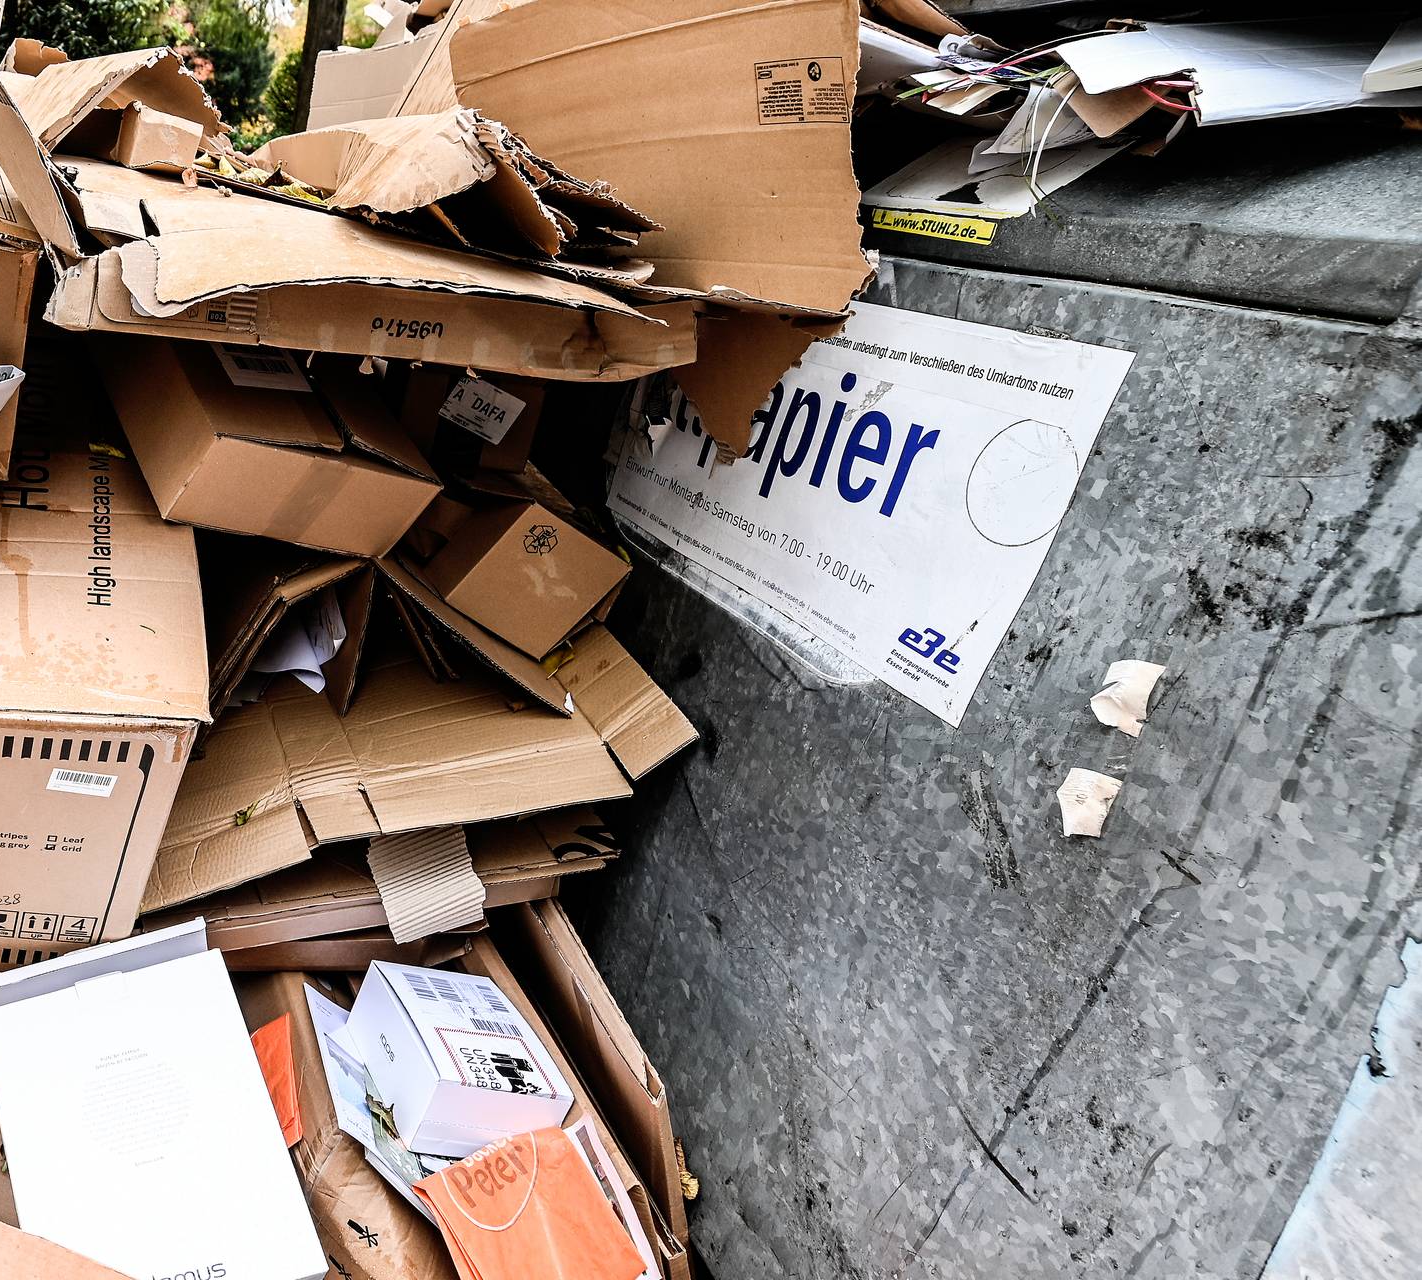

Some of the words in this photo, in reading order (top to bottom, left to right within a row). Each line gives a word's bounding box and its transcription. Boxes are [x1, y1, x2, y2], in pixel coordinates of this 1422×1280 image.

[891, 217, 977, 238] www.STUHL2.de
[852, 340, 888, 359] unbedingt
[889, 348, 906, 361] zum
[909, 352, 965, 375] Verschließen
[967, 364, 984, 379] des
[986, 366, 1038, 392] Umkartons
[1039, 381, 1074, 400] nutzen
[471, 397, 507, 424] DAFA
[88, 474, 114, 561] landscape
[626, 456, 656, 482] Einwurf
[654, 472, 669, 487] nur
[669, 477, 698, 508] Montag
[711, 501, 755, 538] Samstag
[757, 524, 776, 545] von
[779, 533, 805, 558] 7.00
[815, 552, 848, 581] 19.00
[850, 569, 875, 594] Uhr
[87, 565, 116, 607] High
[886, 658, 902, 670] Essen
[903, 668, 921, 681] GmbH
[891, 649, 949, 688] Entsorgungsbetriebe
[8, 842, 30, 850] grey
[61, 845, 82, 853] Grid
[63, 836, 85, 844] Leaf
[449, 1146, 528, 1209] Peter
